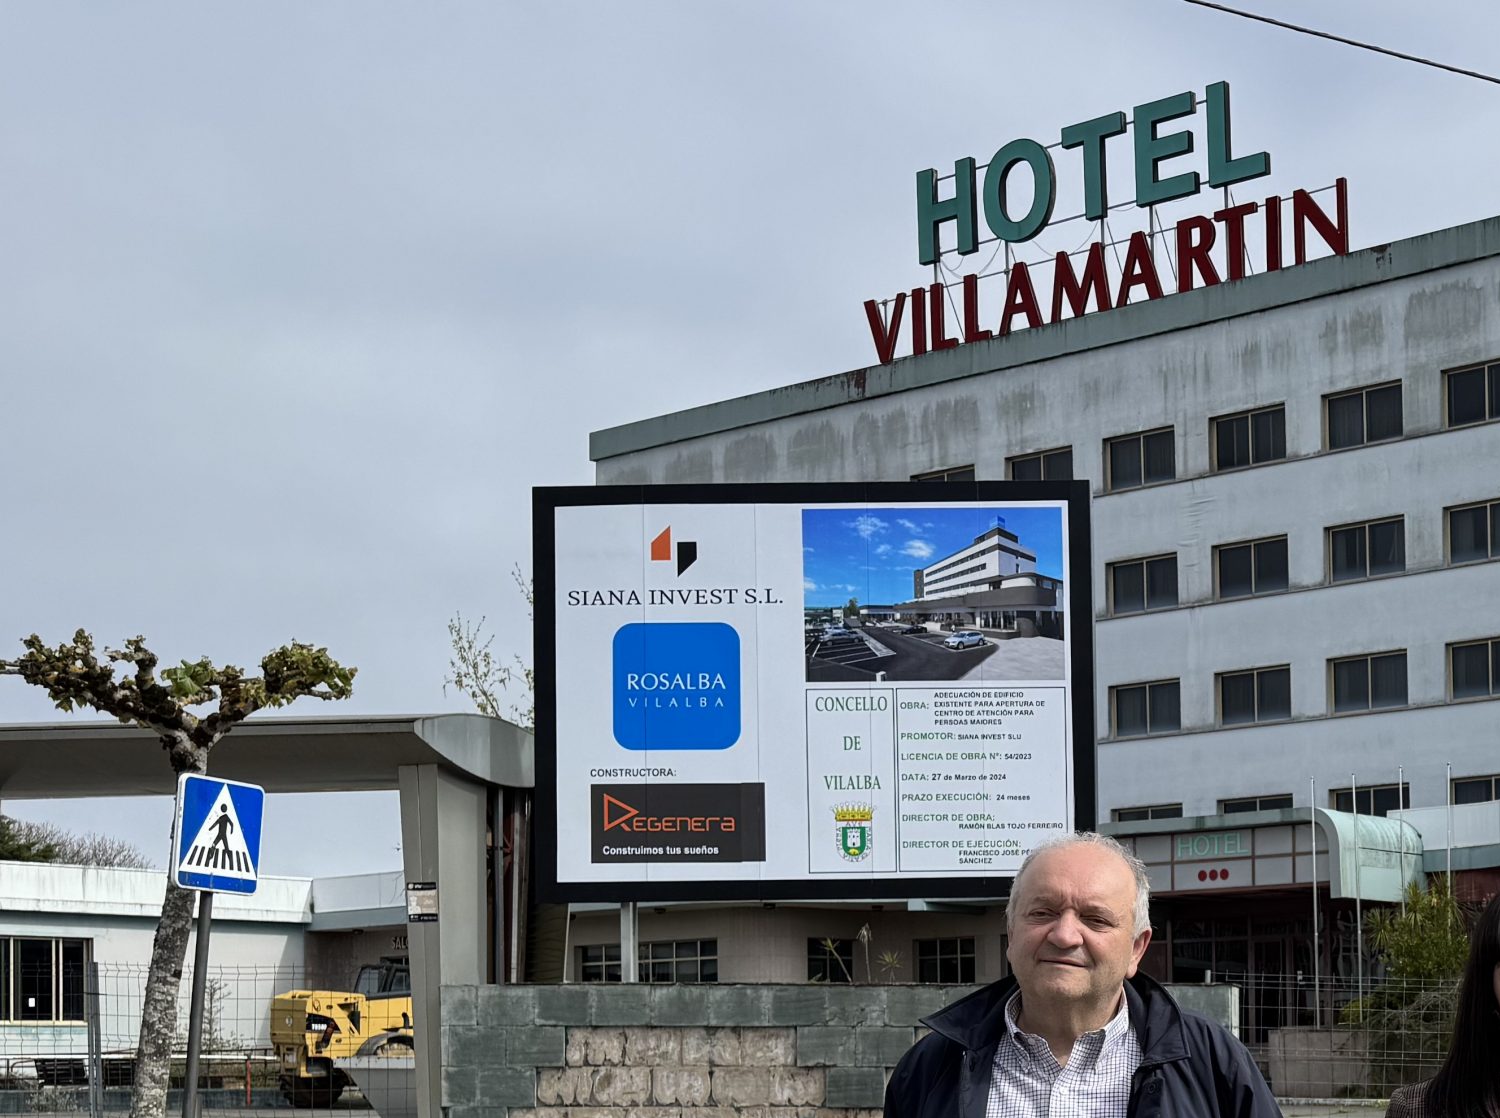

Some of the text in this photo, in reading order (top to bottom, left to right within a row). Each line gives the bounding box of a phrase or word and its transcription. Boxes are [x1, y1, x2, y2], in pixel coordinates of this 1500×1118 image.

[916, 80, 1270, 266] HOTEL
[864, 177, 1349, 364] VILLAMARTIN
[568, 588, 784, 606] SIANA INVEST S.L.
[627, 673, 726, 690] ROSALBA
[934, 691, 981, 699] ADECUACIÓN
[629, 697, 724, 708] VILALBA
[815, 696, 888, 712] CONCELLO
[900, 702, 929, 710] OBRA:
[976, 709, 1013, 717] ATENCIÓN
[901, 732, 956, 740] PROMOTOR:
[843, 735, 861, 751] DE
[960, 752, 987, 760] OBRA
[590, 768, 677, 777] CONSTRUCTORA:
[901, 773, 929, 781] DATA:
[931, 773, 941, 781] 27
[989, 773, 1006, 781] 2024
[823, 775, 882, 790] VILALBA
[901, 793, 933, 801] PRAZO
[935, 792, 992, 801] EXECUCIÓN:
[902, 814, 949, 822] DIRECTOR
[951, 814, 963, 822] DE
[958, 822, 985, 830] RAMÓN
[1007, 822, 1026, 830] TOJO
[902, 838, 1022, 848] DIRECTOR DE EJECUCIÓN:
[1176, 832, 1250, 858] HOTEL
[602, 845, 719, 855] Construimos tus sueños
[958, 849, 1000, 857] FRANCISCO
[958, 857, 993, 865] SÁNCHEZ
